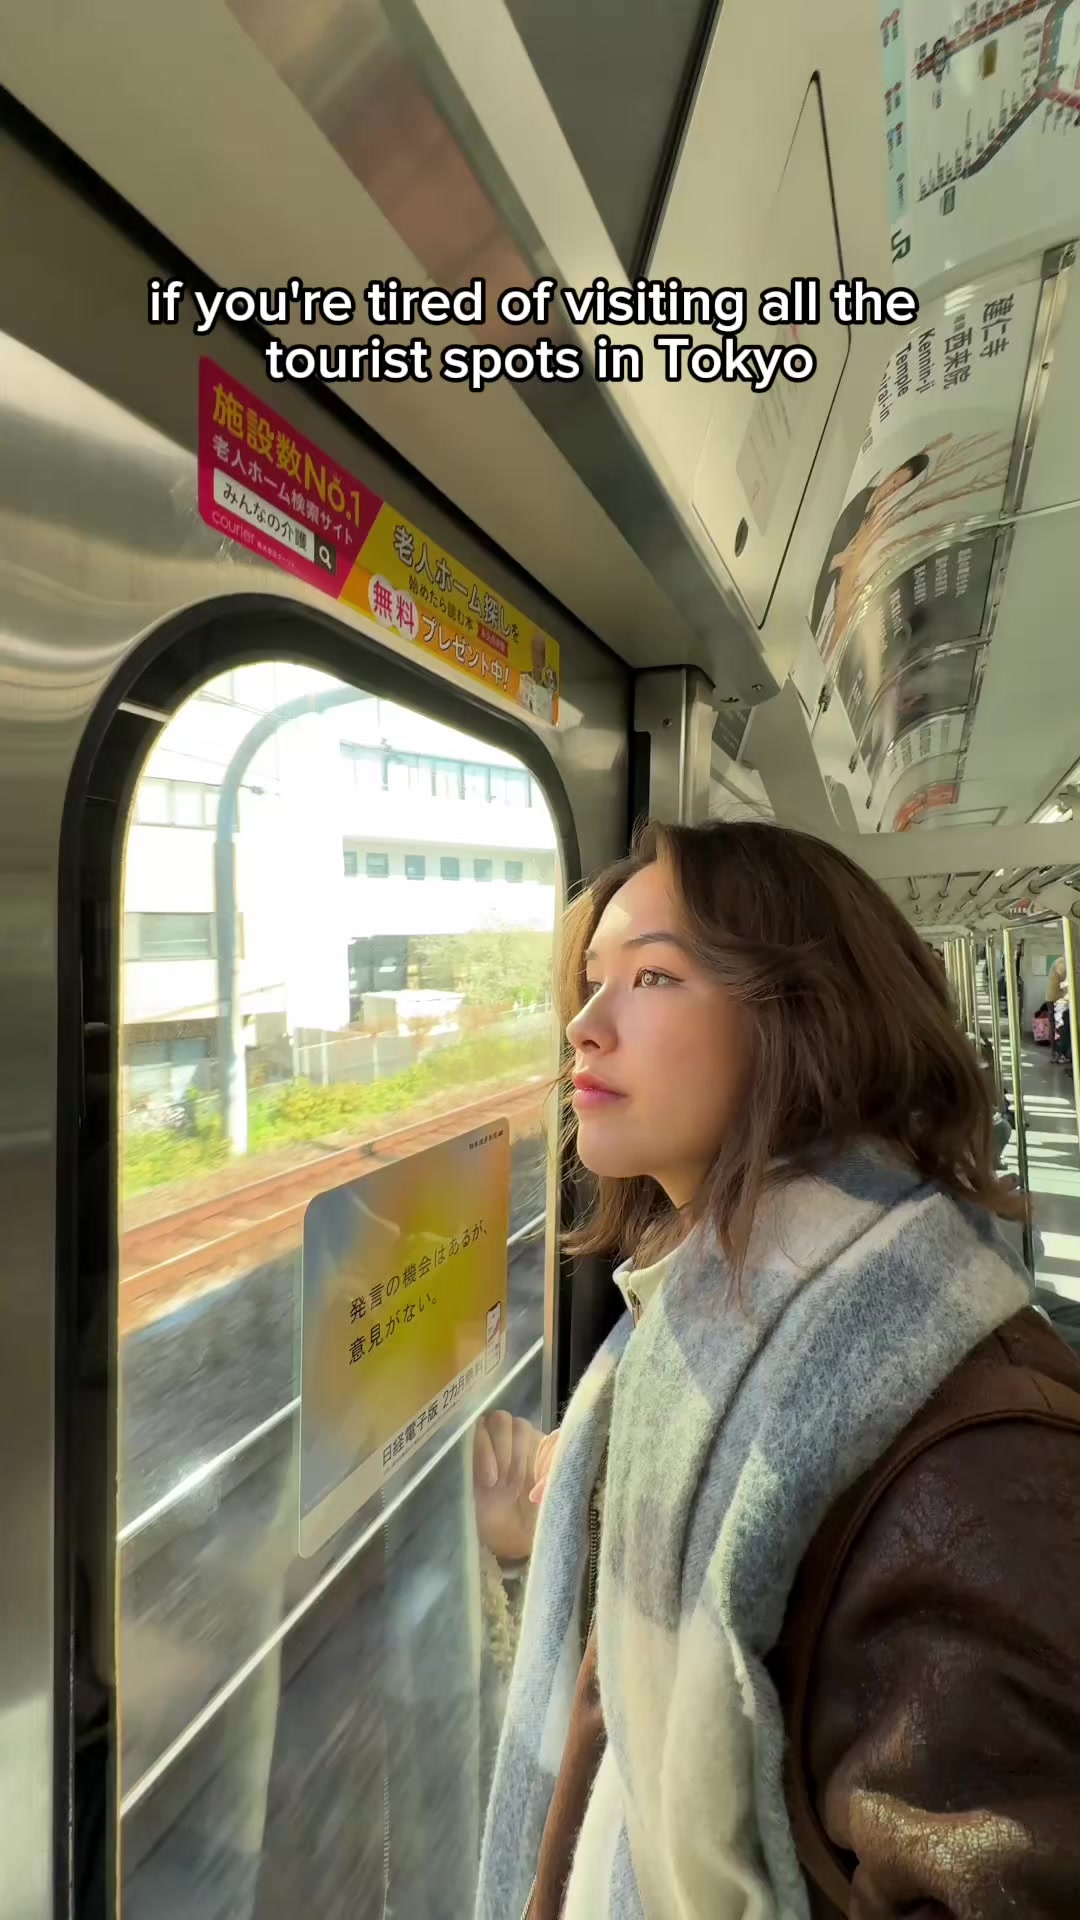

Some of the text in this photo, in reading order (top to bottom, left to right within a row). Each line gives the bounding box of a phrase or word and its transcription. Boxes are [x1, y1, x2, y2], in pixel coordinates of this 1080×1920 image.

[890, 228, 911, 265] JR
[943, 326, 973, 391] 西来院
[979, 293, 1015, 358] 建仁寺
[893, 341, 913, 398] Temple
[915, 327, 936, 395] Kennin-ji
[222, 482, 308, 552] みんなの介護
[372, 579, 415, 635] 無料
[349, 1219, 488, 1325] 発言の機会はあるが、
[348, 1292, 437, 1366] 意見がない。
[382, 1399, 439, 1468] 日経電子版
